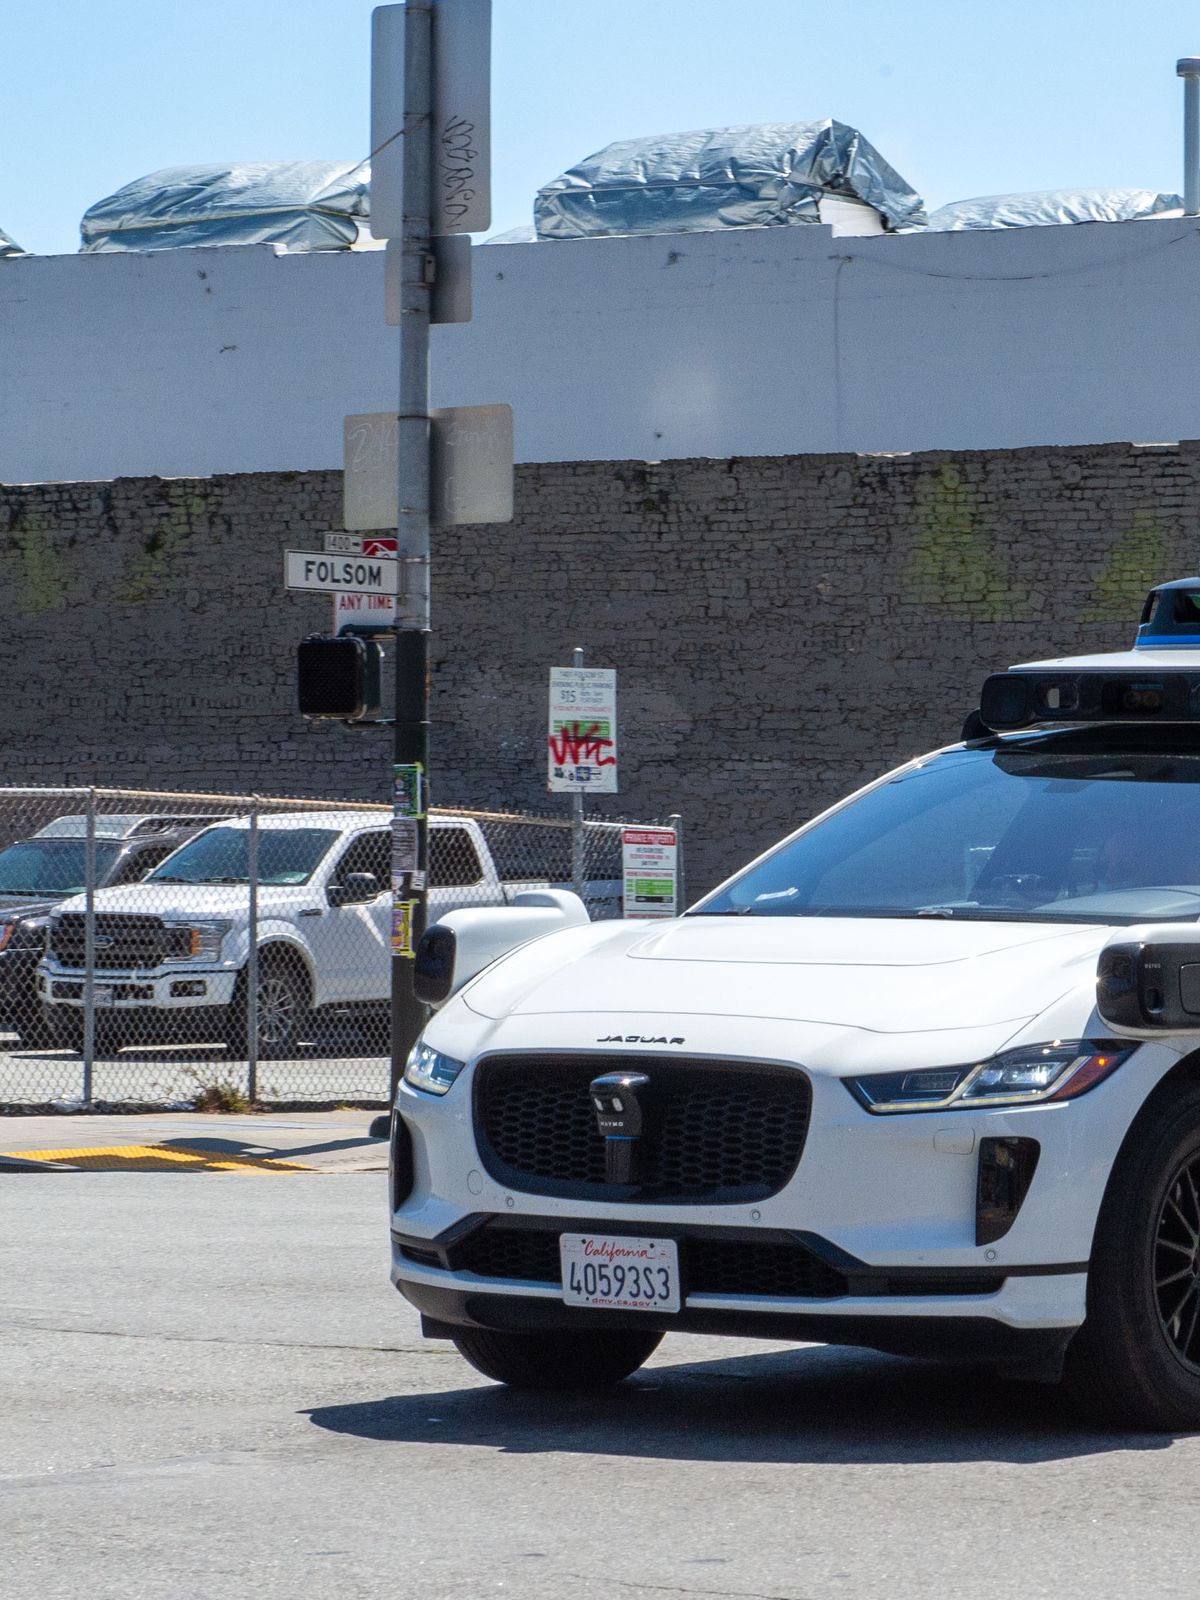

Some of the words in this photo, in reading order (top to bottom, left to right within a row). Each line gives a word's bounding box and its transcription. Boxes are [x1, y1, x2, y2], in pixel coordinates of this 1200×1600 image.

[304, 560, 382, 587] FOLSOM
[339, 595, 363, 610] ANY
[368, 596, 393, 610] TIME
[597, 1035, 685, 1045] JAGUAR
[584, 1239, 656, 1262] California
[570, 1261, 670, 1301] 40593S3
